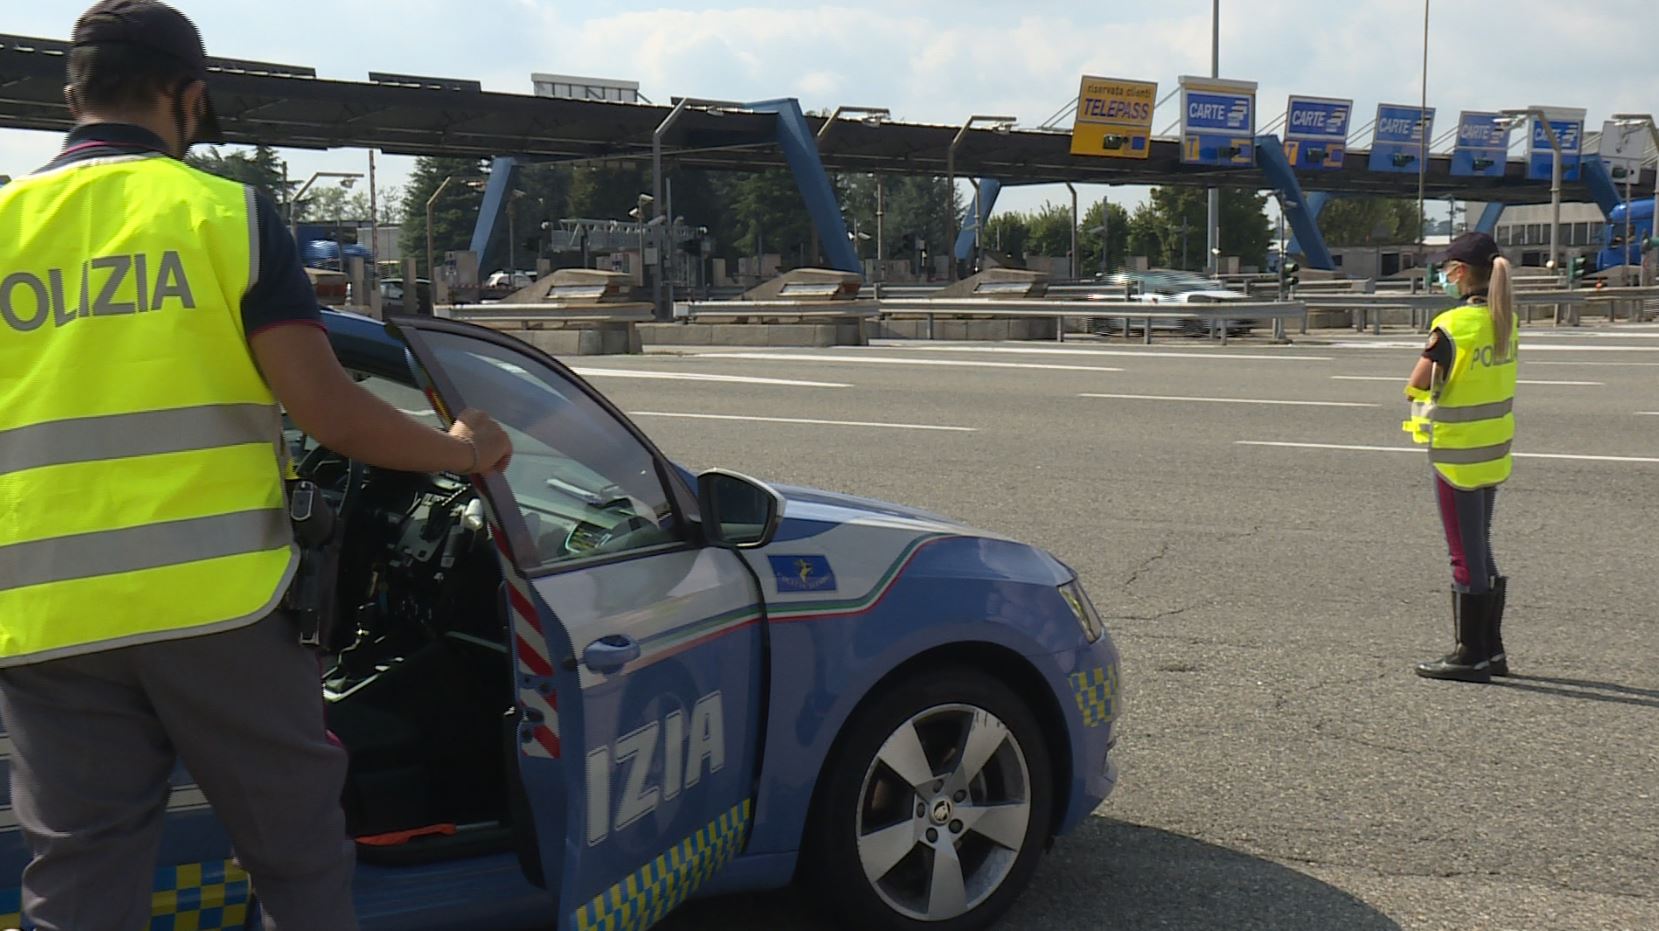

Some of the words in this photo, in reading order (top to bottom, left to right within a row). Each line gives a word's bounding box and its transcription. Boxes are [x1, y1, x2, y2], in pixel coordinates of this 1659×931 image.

[1084, 97, 1150, 120] TELEPASS
[1189, 102, 1225, 121] CARTE
[1292, 110, 1327, 128] CARTE
[1378, 117, 1412, 134] CARTE
[1461, 123, 1491, 140] CARTE
[1534, 127, 1562, 142] CAE
[0, 251, 196, 332] OLIZIA
[586, 689, 726, 847] IZIA
